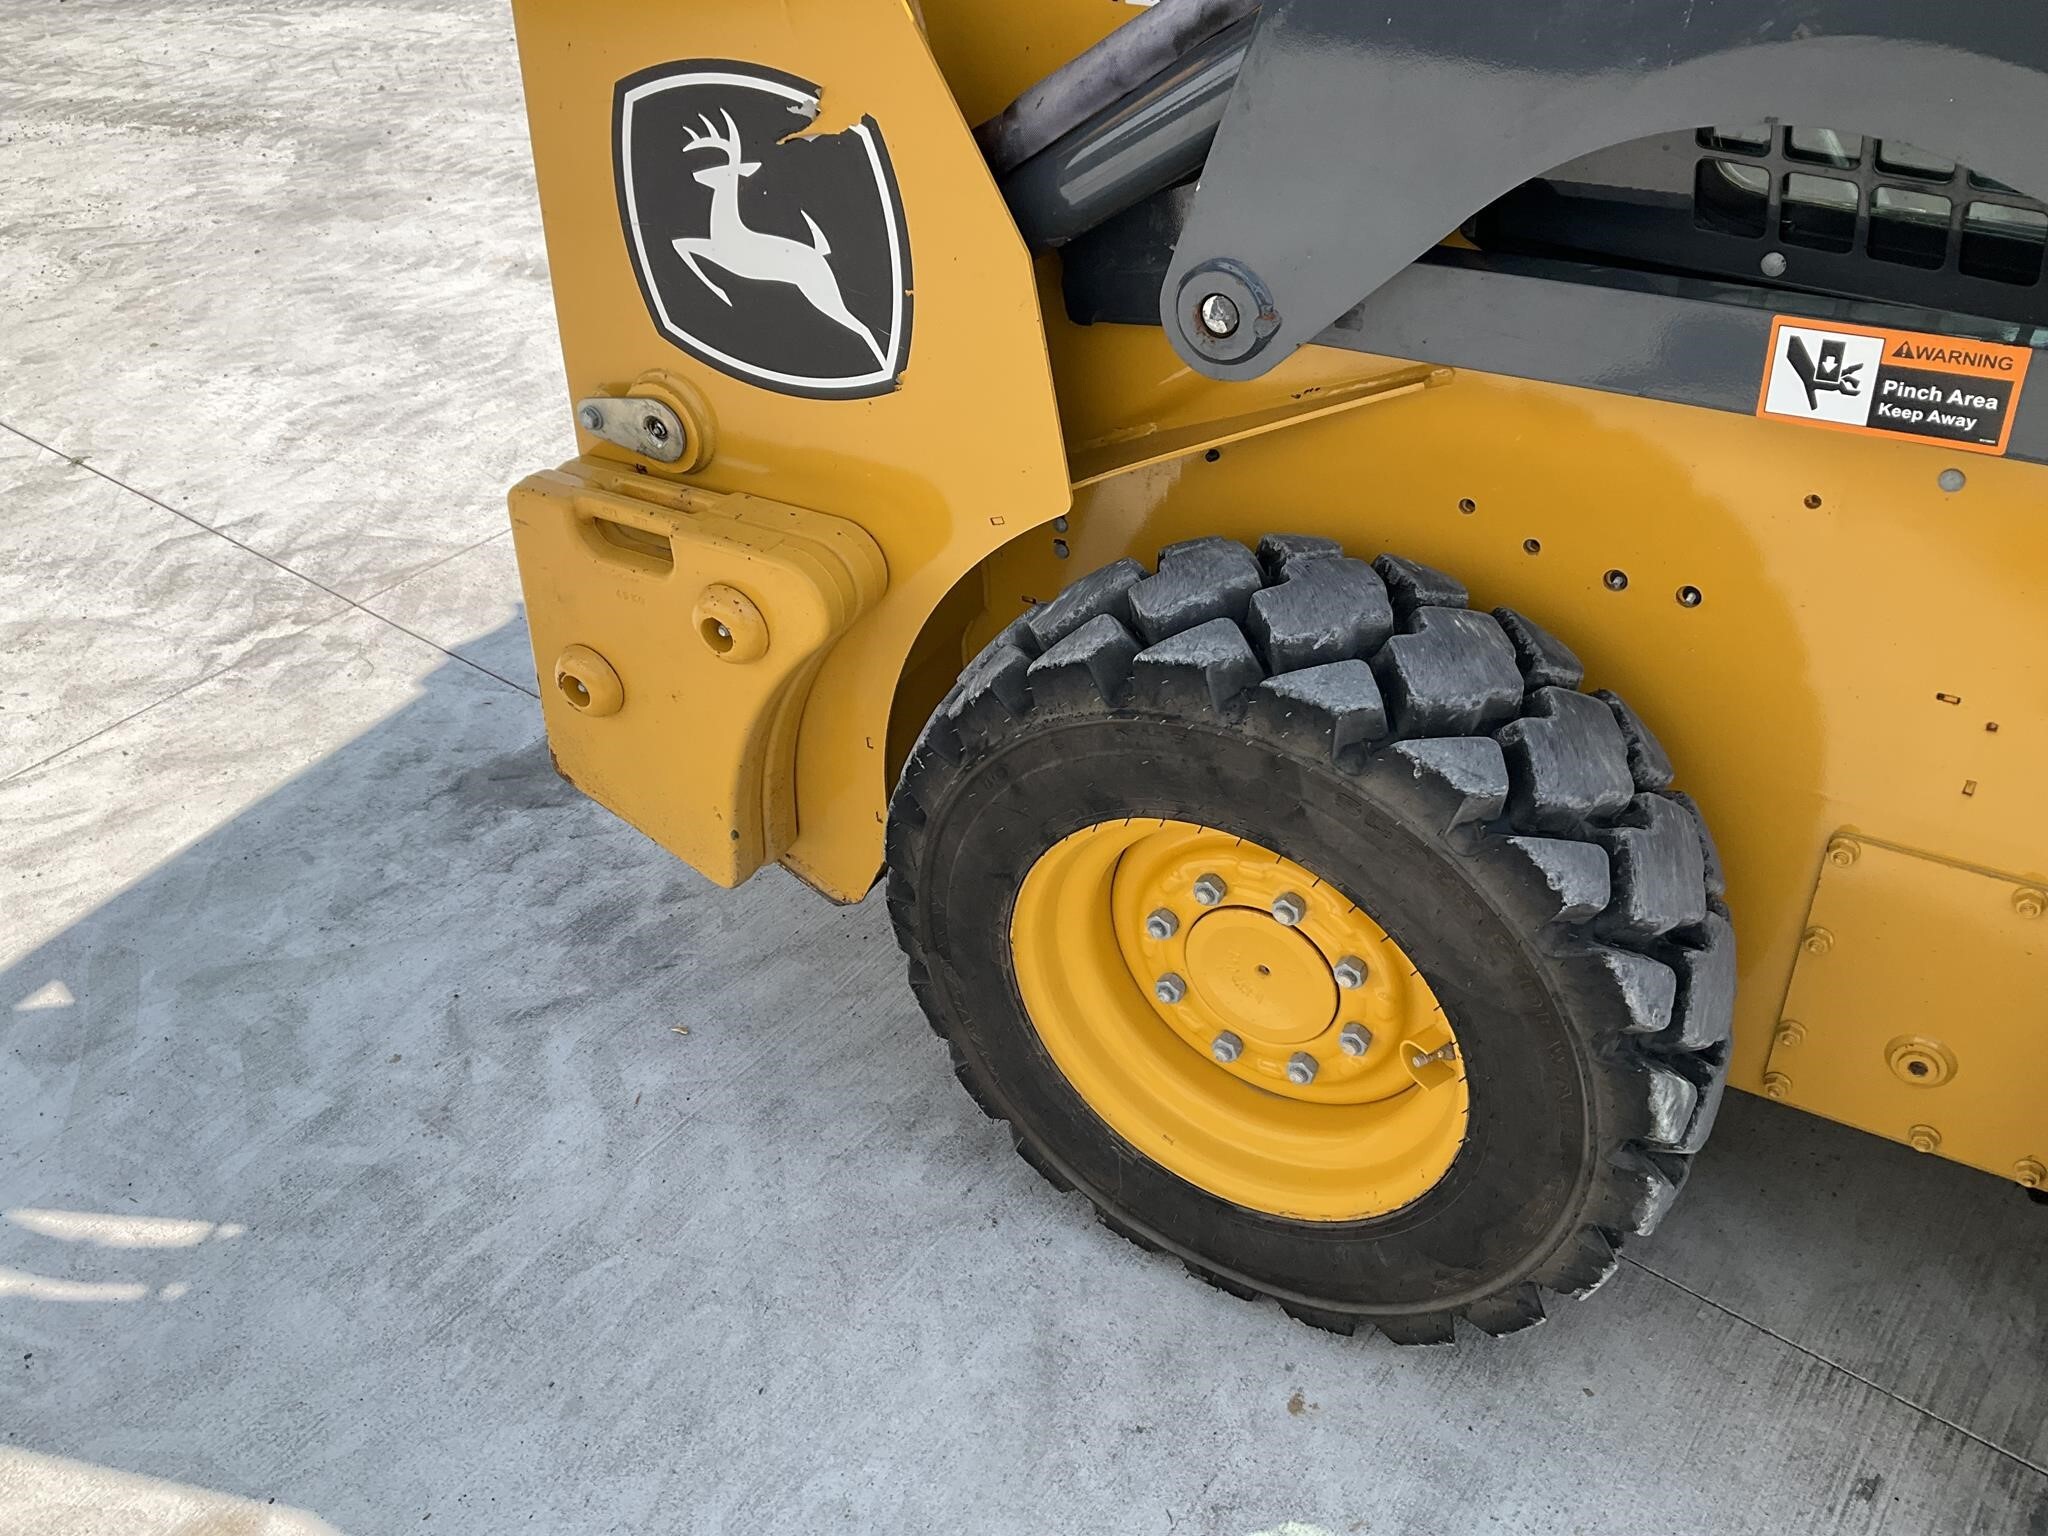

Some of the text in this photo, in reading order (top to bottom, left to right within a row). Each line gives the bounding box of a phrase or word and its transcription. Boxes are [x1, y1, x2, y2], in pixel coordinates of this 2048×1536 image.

[1916, 345, 2014, 371] WARNING
[1882, 379, 1999, 411] Pinch Area
[1877, 402, 1978, 431] Keep Away
